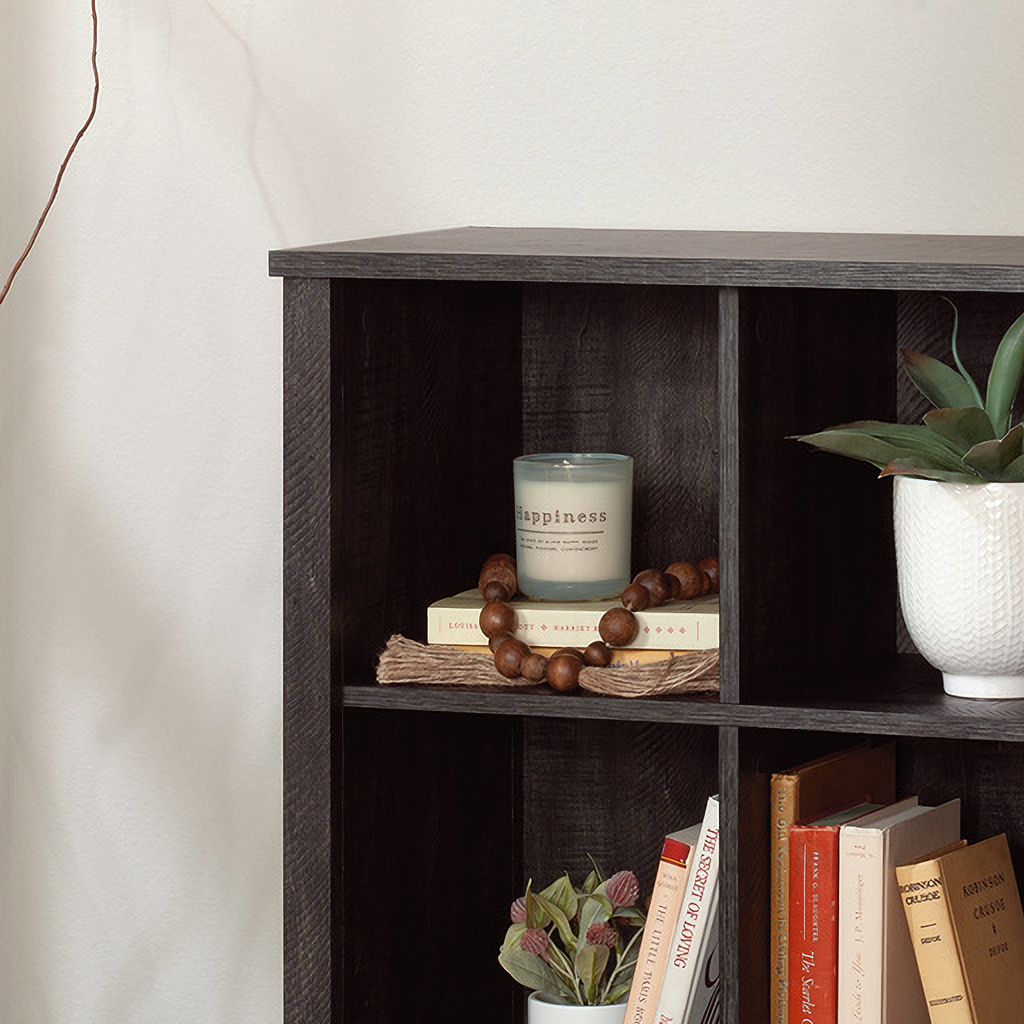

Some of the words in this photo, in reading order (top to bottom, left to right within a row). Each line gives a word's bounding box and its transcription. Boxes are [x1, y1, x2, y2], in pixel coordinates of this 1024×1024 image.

[516, 506, 607, 526] Happiness
[702, 826, 719, 854] THE
[690, 853, 712, 901] SECRET
[962, 873, 1005, 898] ROBINSON
[655, 904, 667, 923] THE
[685, 901, 701, 920] OF
[672, 920, 696, 968] LOVING
[801, 950, 814, 972] The
[800, 976, 814, 1013] Scarlet
